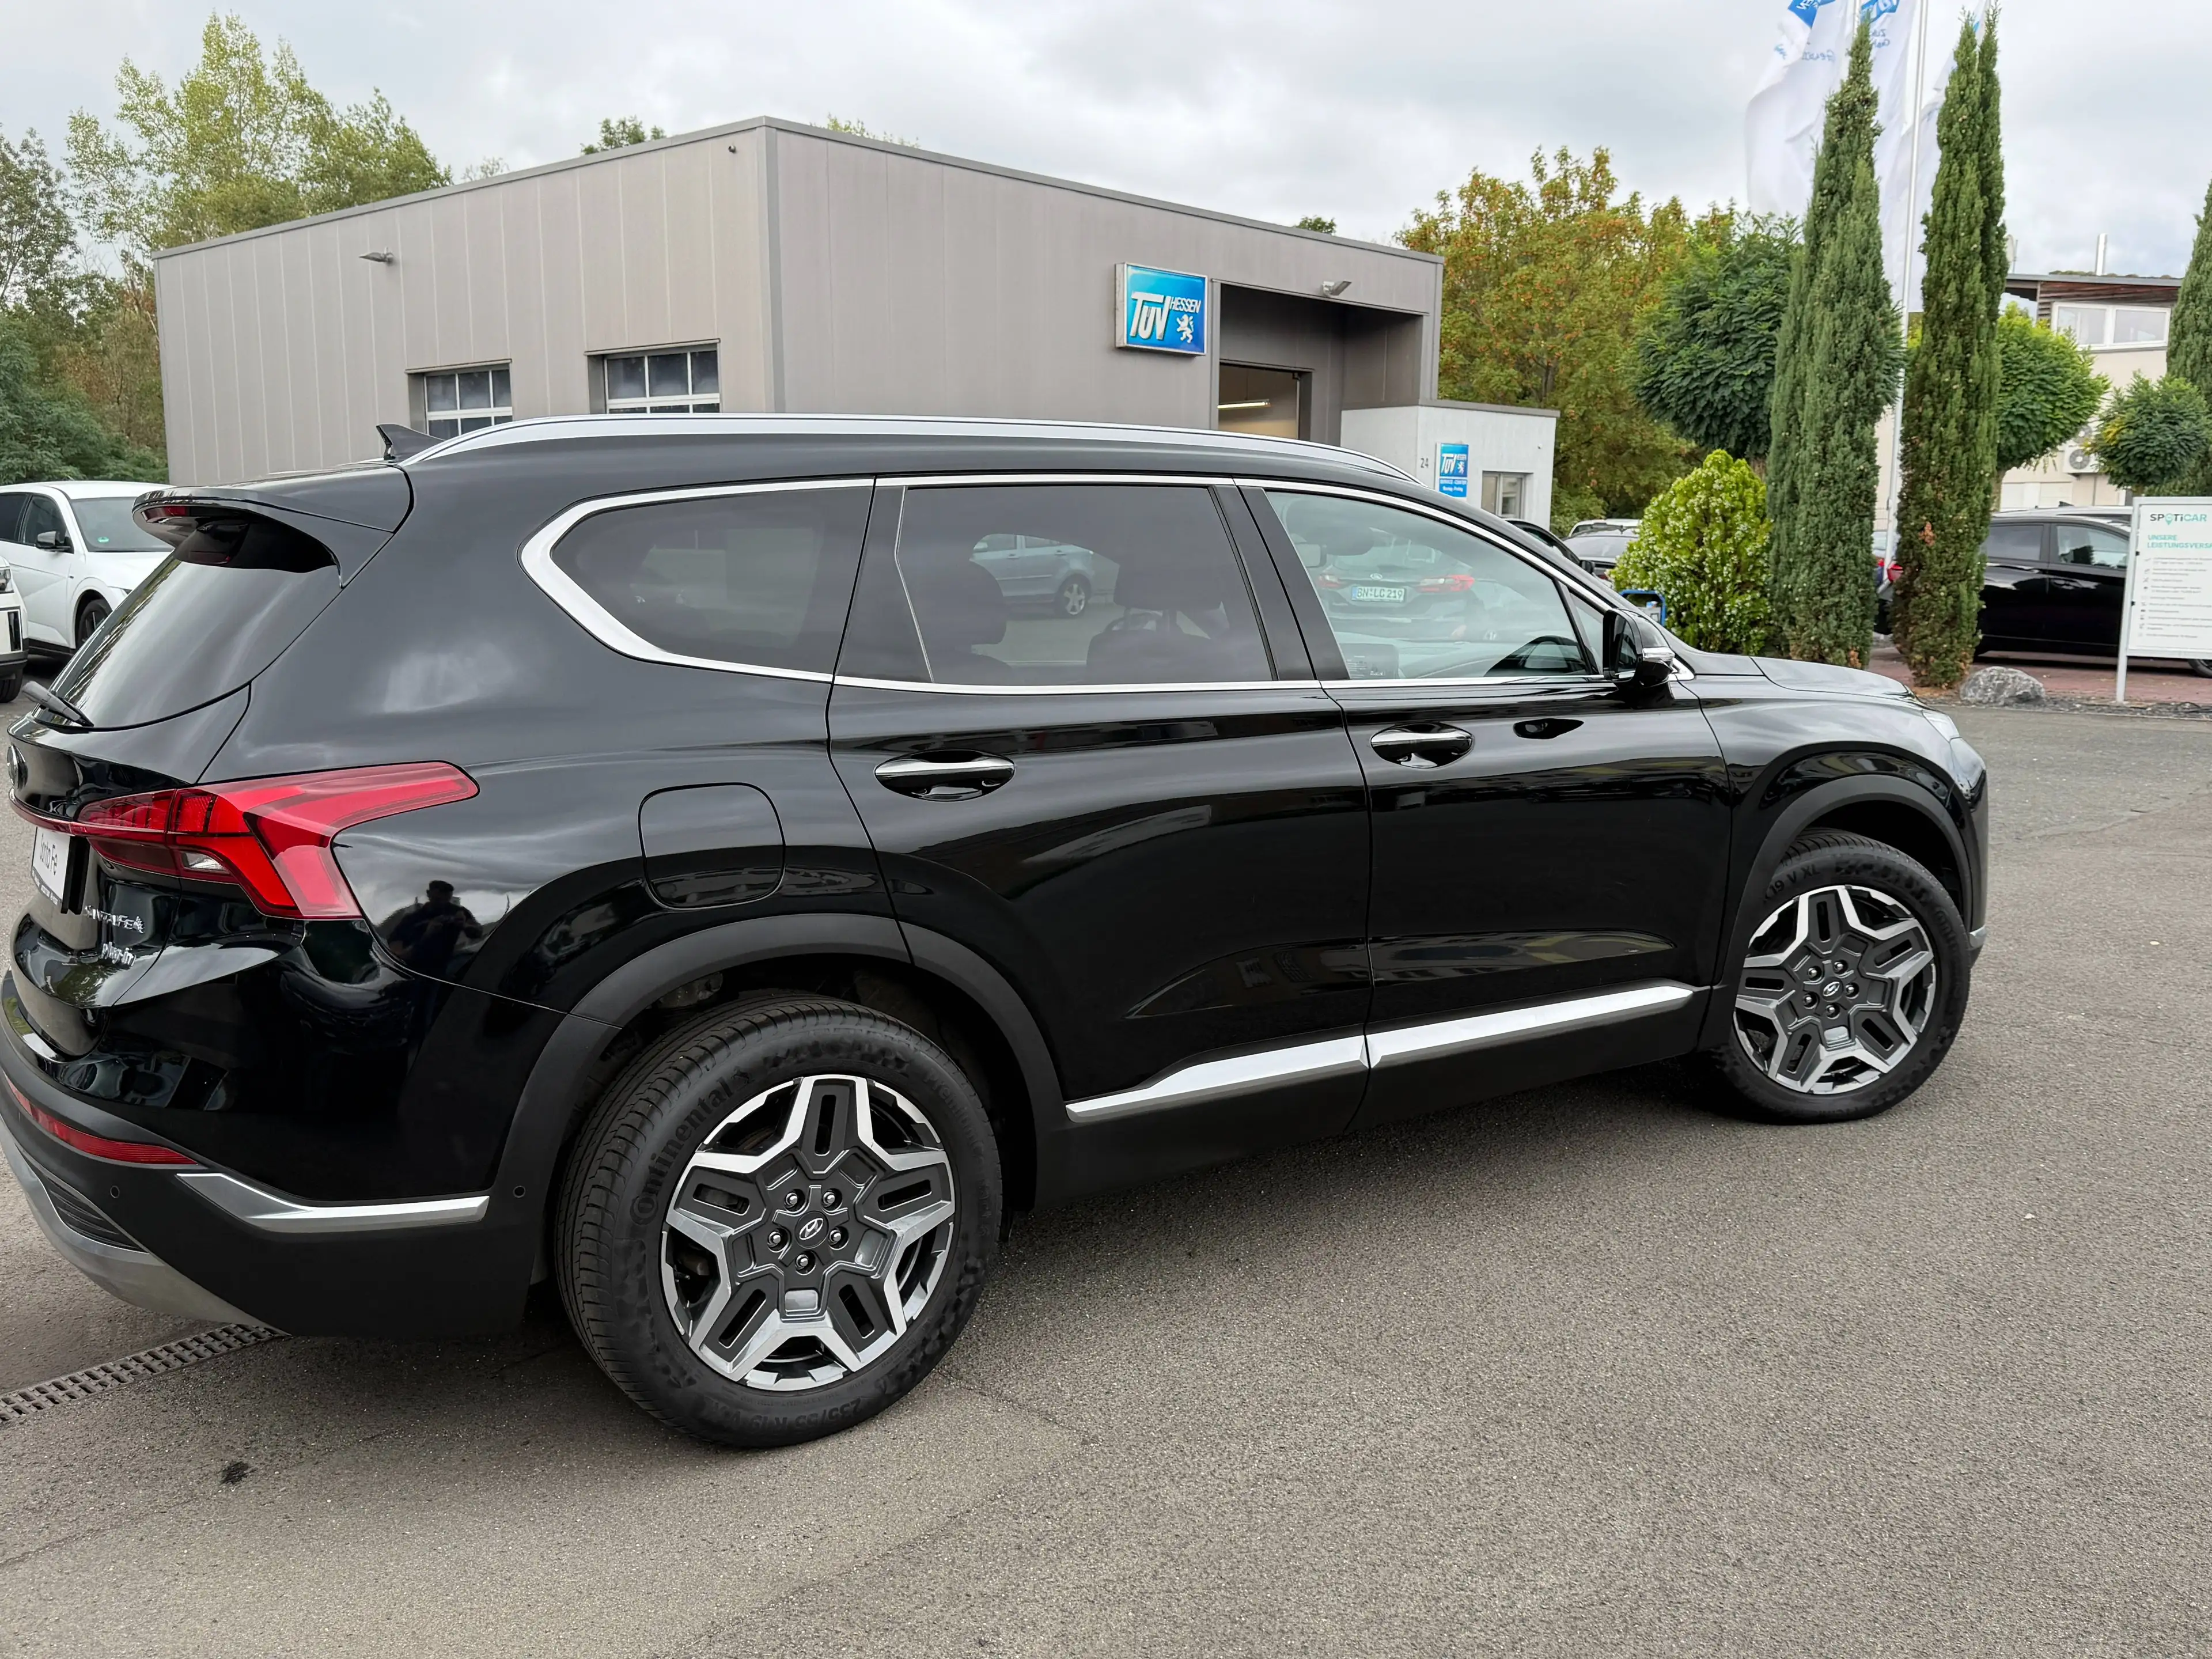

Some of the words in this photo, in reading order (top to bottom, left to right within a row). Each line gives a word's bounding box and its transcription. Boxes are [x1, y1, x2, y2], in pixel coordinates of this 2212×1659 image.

[1130, 291, 1172, 340] TÜV
[1170, 297, 1201, 313] HESSEN
[1421, 457, 1429, 468] 24
[1387, 589, 1403, 599] 219
[630, 1076, 734, 1225] Continental
